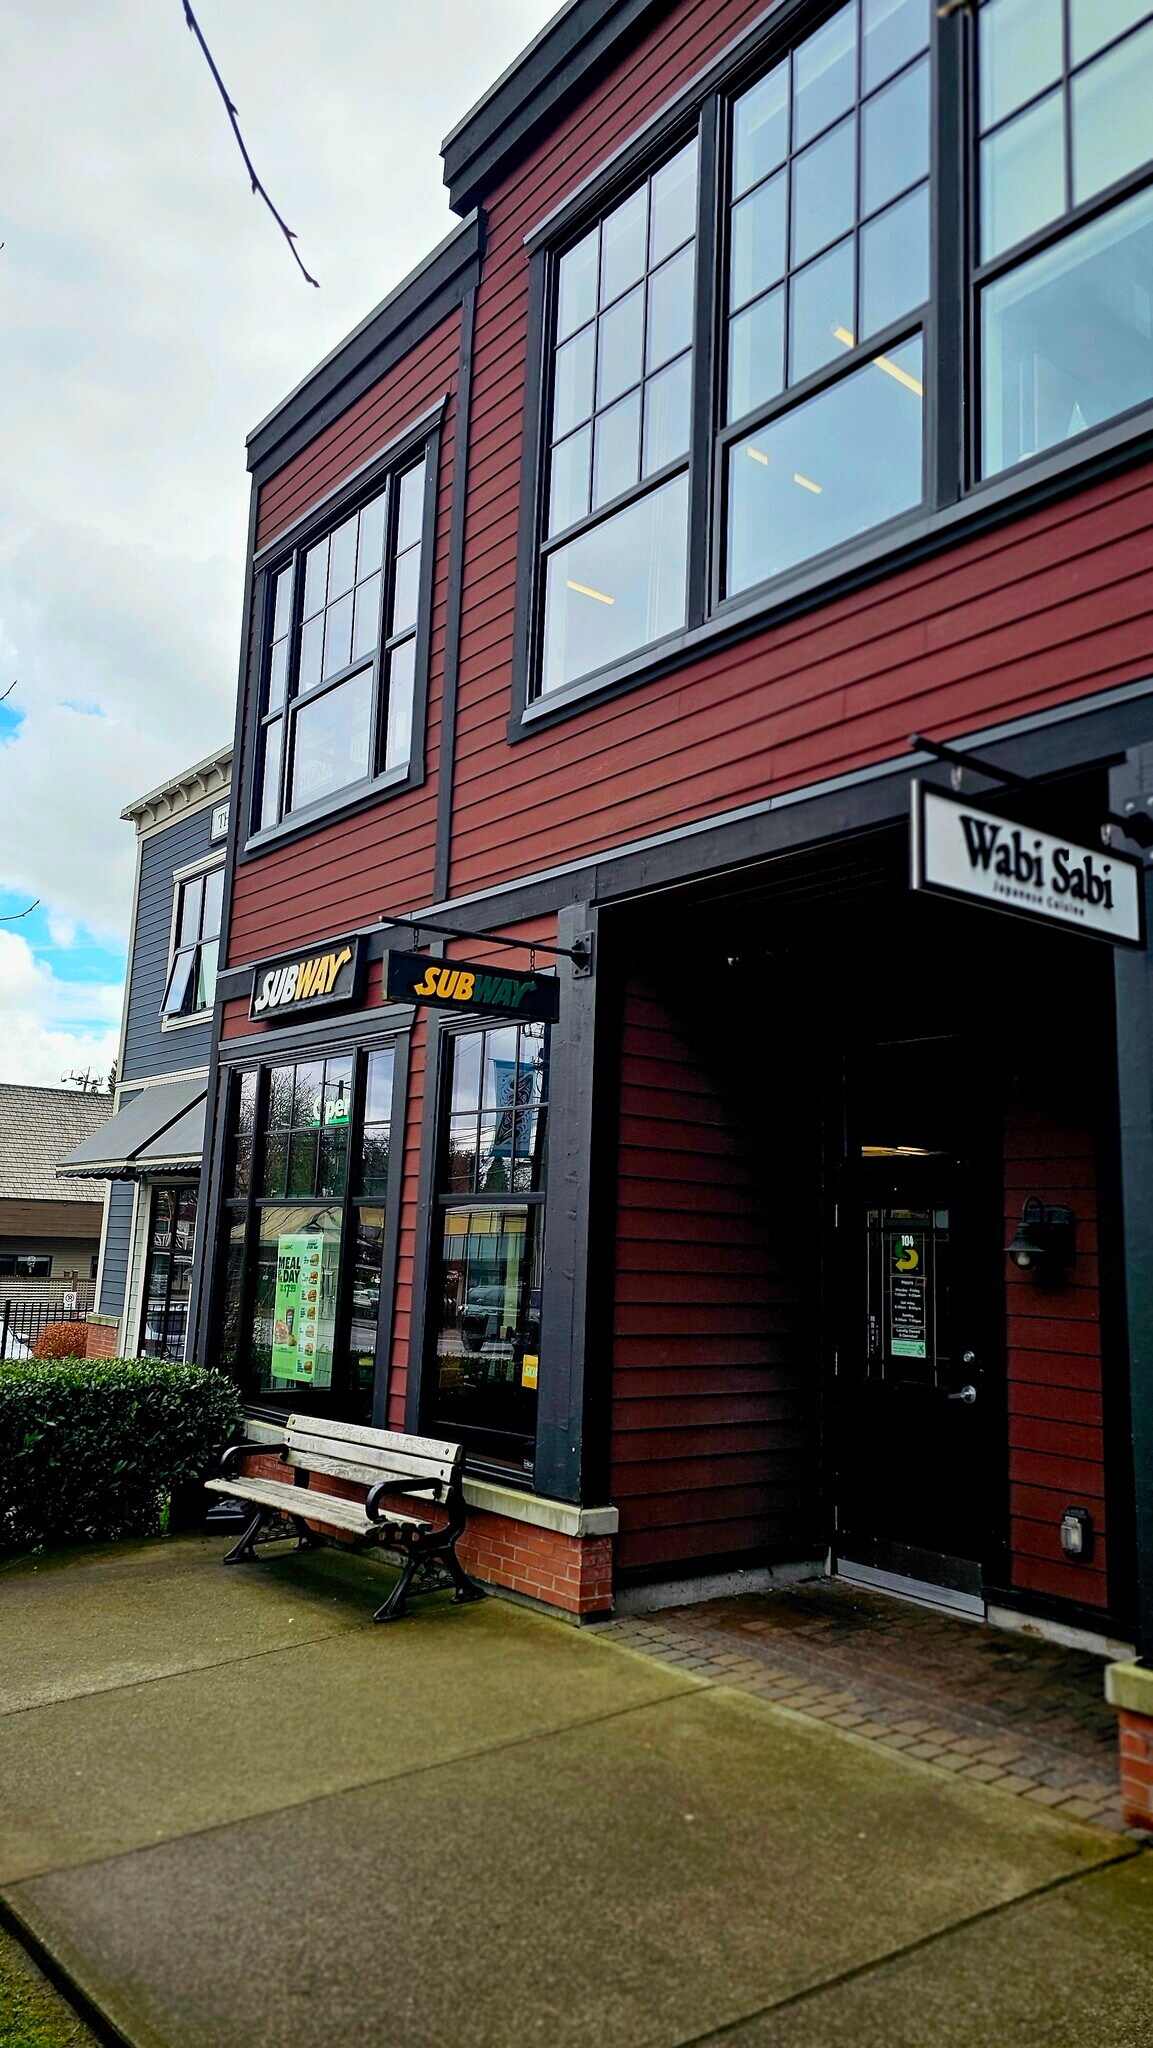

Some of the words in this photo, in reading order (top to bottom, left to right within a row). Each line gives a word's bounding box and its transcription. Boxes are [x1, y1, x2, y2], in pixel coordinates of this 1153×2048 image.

[959, 814, 1044, 888] Wabi
[1052, 847, 1114, 909] Sabi
[992, 880, 1043, 905] Japanese
[254, 946, 352, 1013] SUBWAY
[413, 967, 537, 1008] SUBWAY
[901, 1235, 914, 1247] 104
[279, 1256, 301, 1270] MEAL
[283, 1270, 300, 1284] DAY
